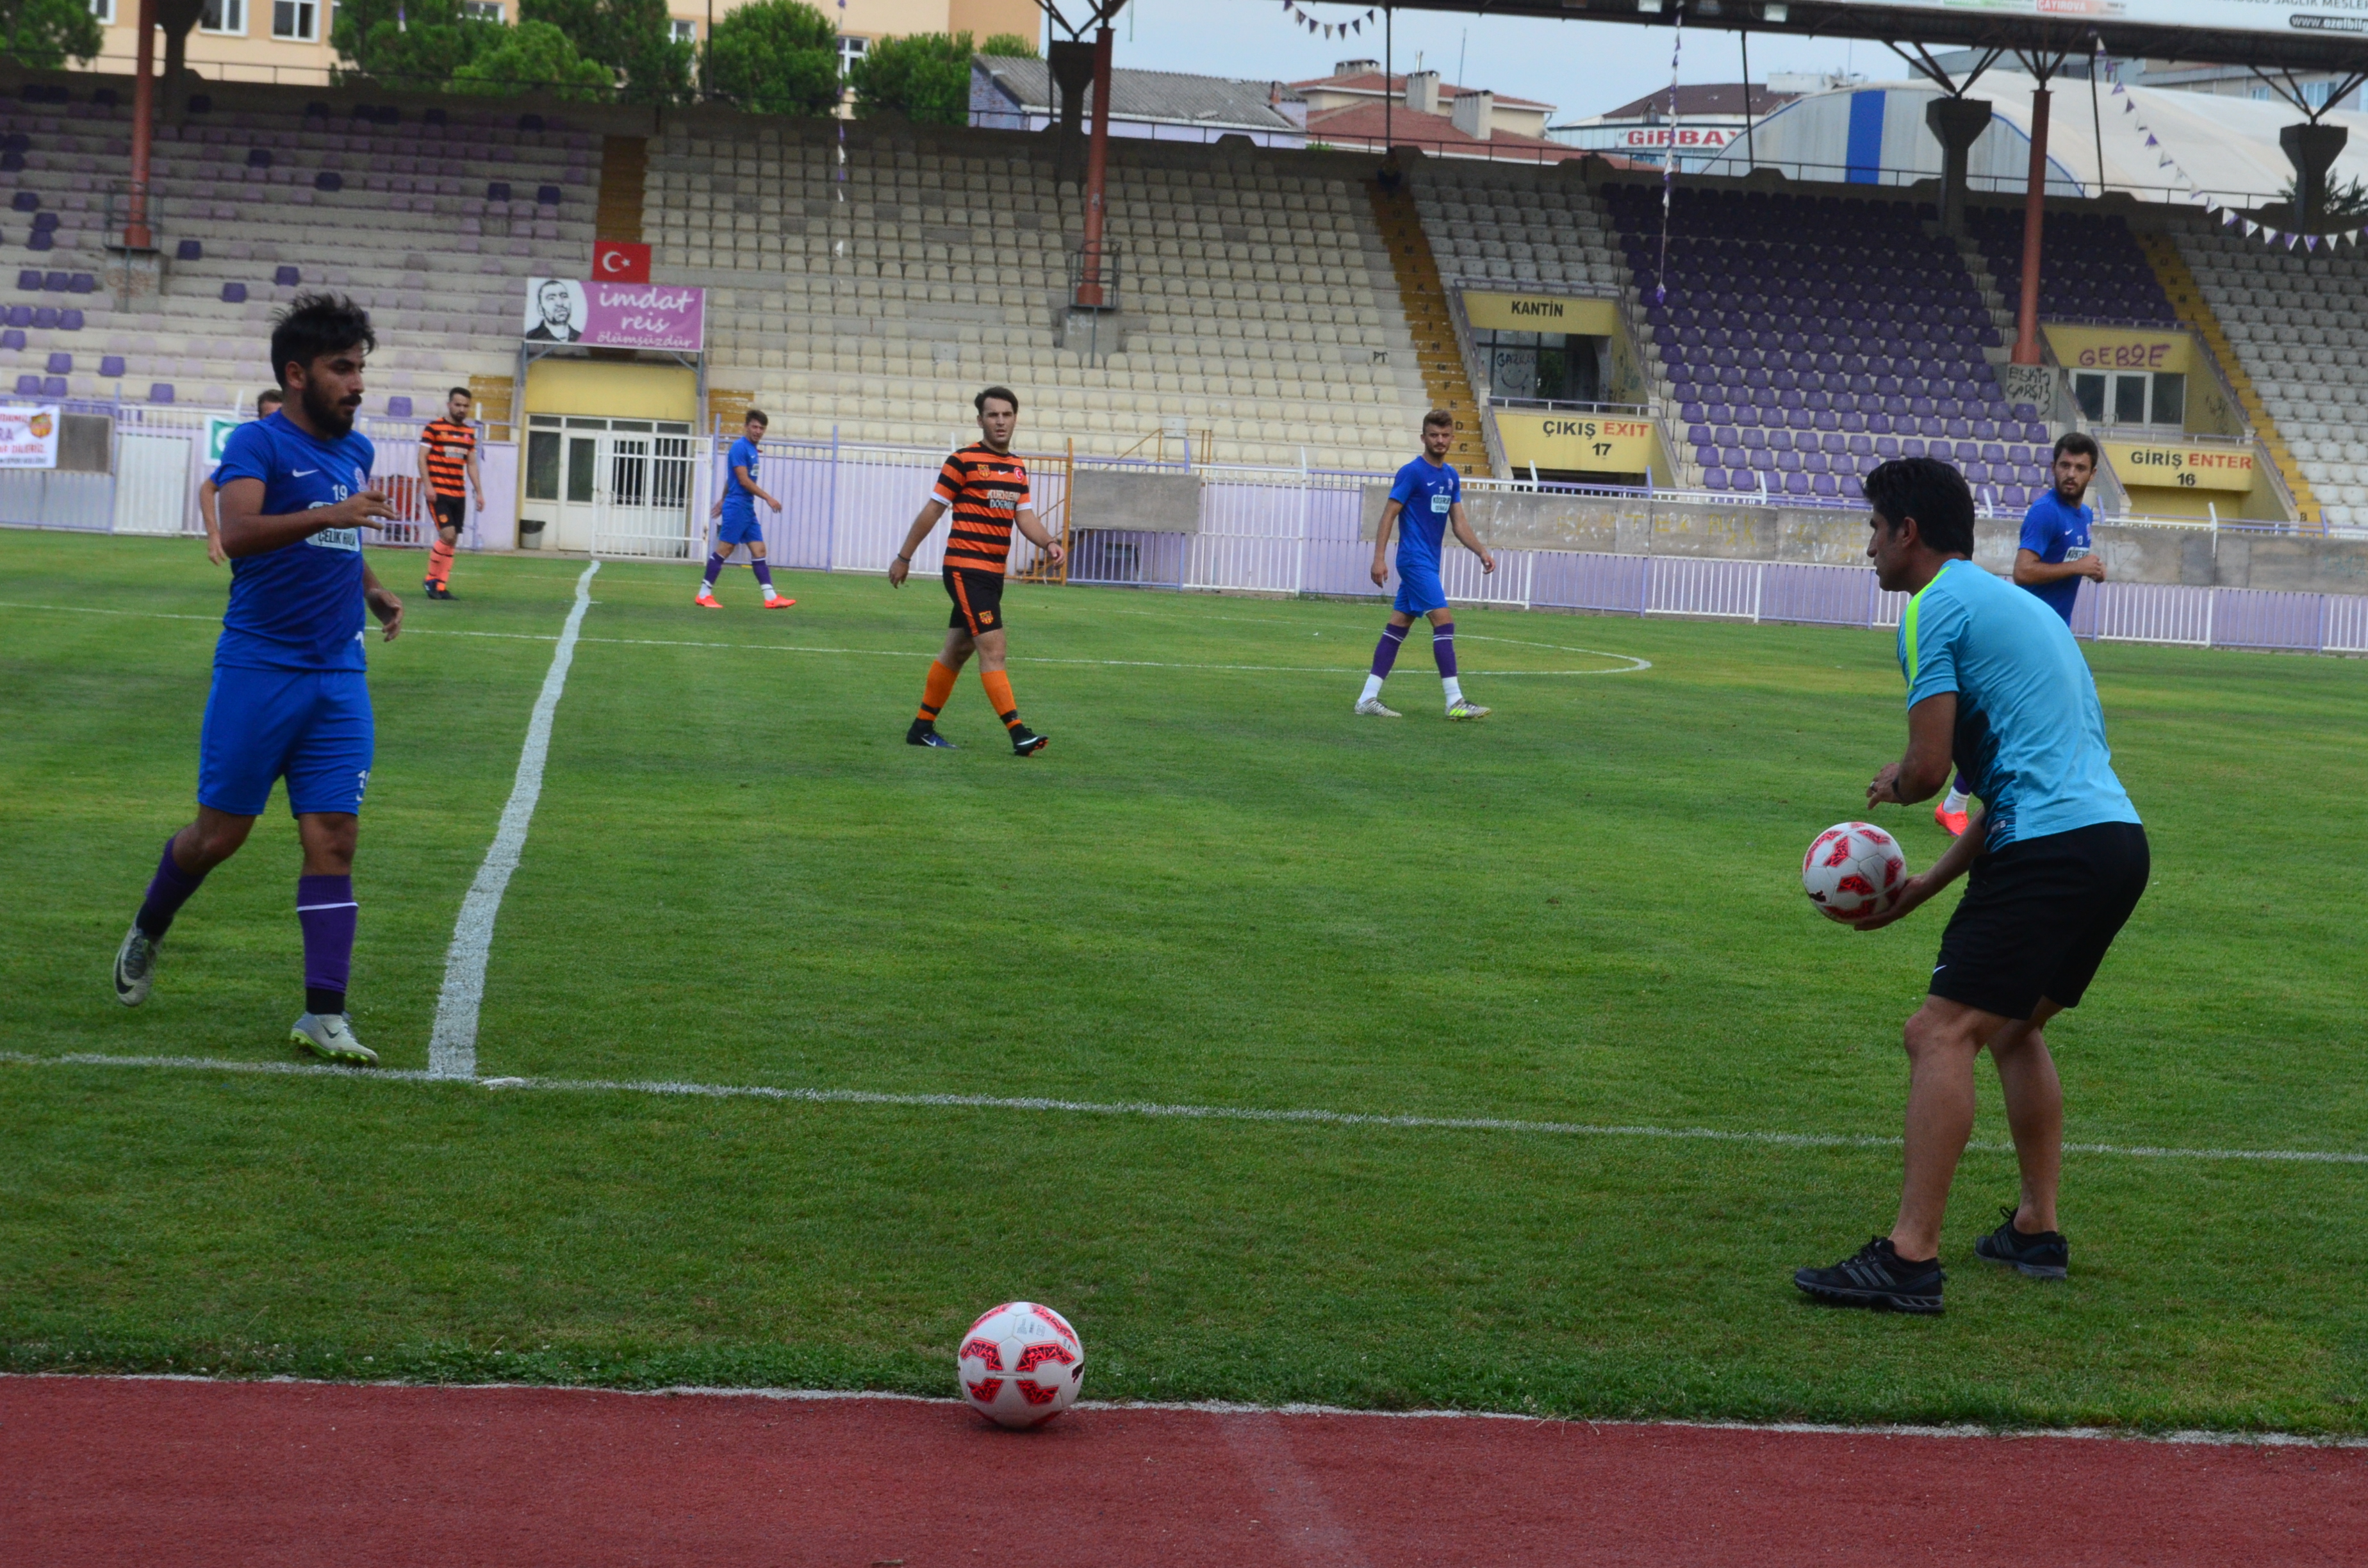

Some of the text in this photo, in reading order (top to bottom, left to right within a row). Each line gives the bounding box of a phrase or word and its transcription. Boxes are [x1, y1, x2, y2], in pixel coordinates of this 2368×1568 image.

[599, 284, 695, 314] imdat
[1511, 300, 1564, 317] KANTİN
[621, 311, 670, 333] reis
[1455, 421, 1464, 430] D
[1543, 421, 1649, 440] ÇIKIŞ EXIT
[1459, 443, 1468, 452] C
[1592, 443, 1612, 456] 17
[2130, 449, 2253, 470] GİRİŞ ENTER
[1464, 465, 1473, 474] B
[2176, 472, 2196, 487] 16
[332, 484, 349, 502] 19
[2299, 512, 2308, 521] B
